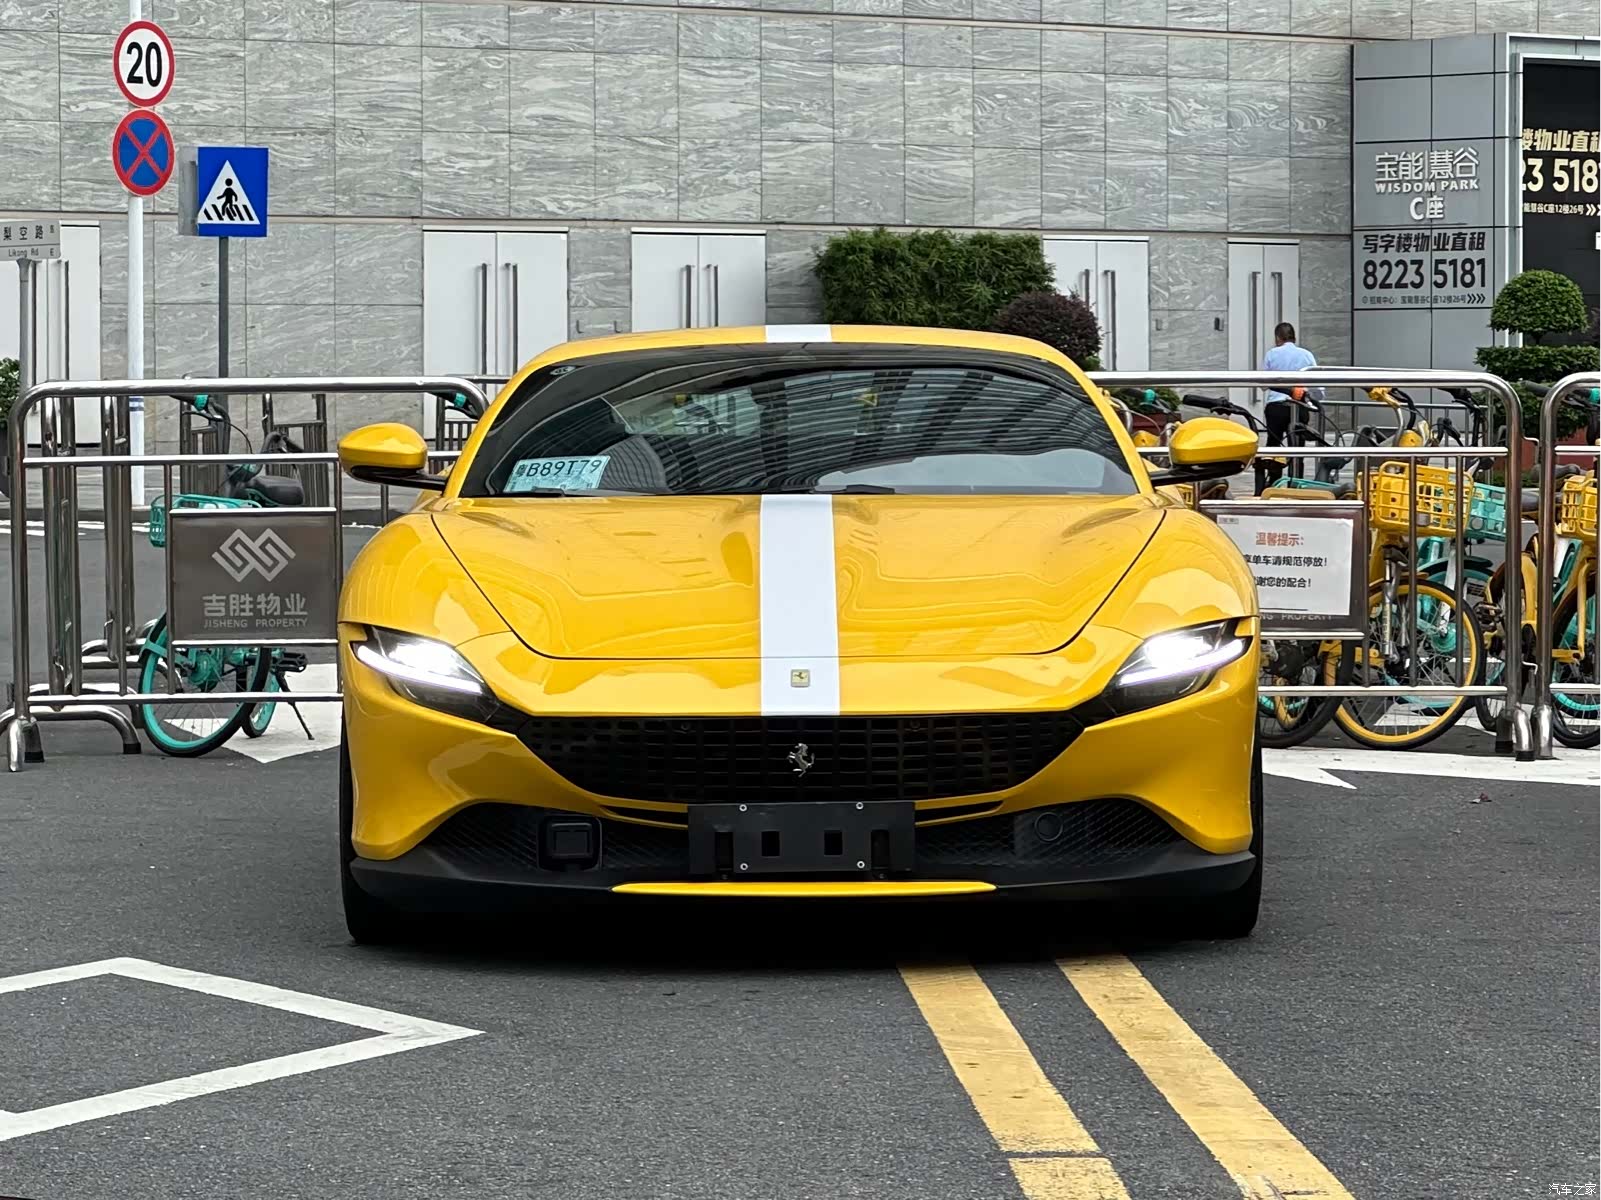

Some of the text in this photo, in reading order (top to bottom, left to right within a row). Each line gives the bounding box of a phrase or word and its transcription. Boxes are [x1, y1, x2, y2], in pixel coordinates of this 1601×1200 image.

[126, 41, 163, 87] 20
[1375, 178, 1479, 194] WISDOM PARK
[1552, 158, 1600, 193] 518
[1409, 195, 1444, 220] C座
[1362, 232, 1486, 253] 写字楼物业直租
[1362, 257, 1486, 290] 8223 5181
[202, 593, 308, 616] 吉胜物业
[204, 618, 308, 628] JISHENG PROPERTY
